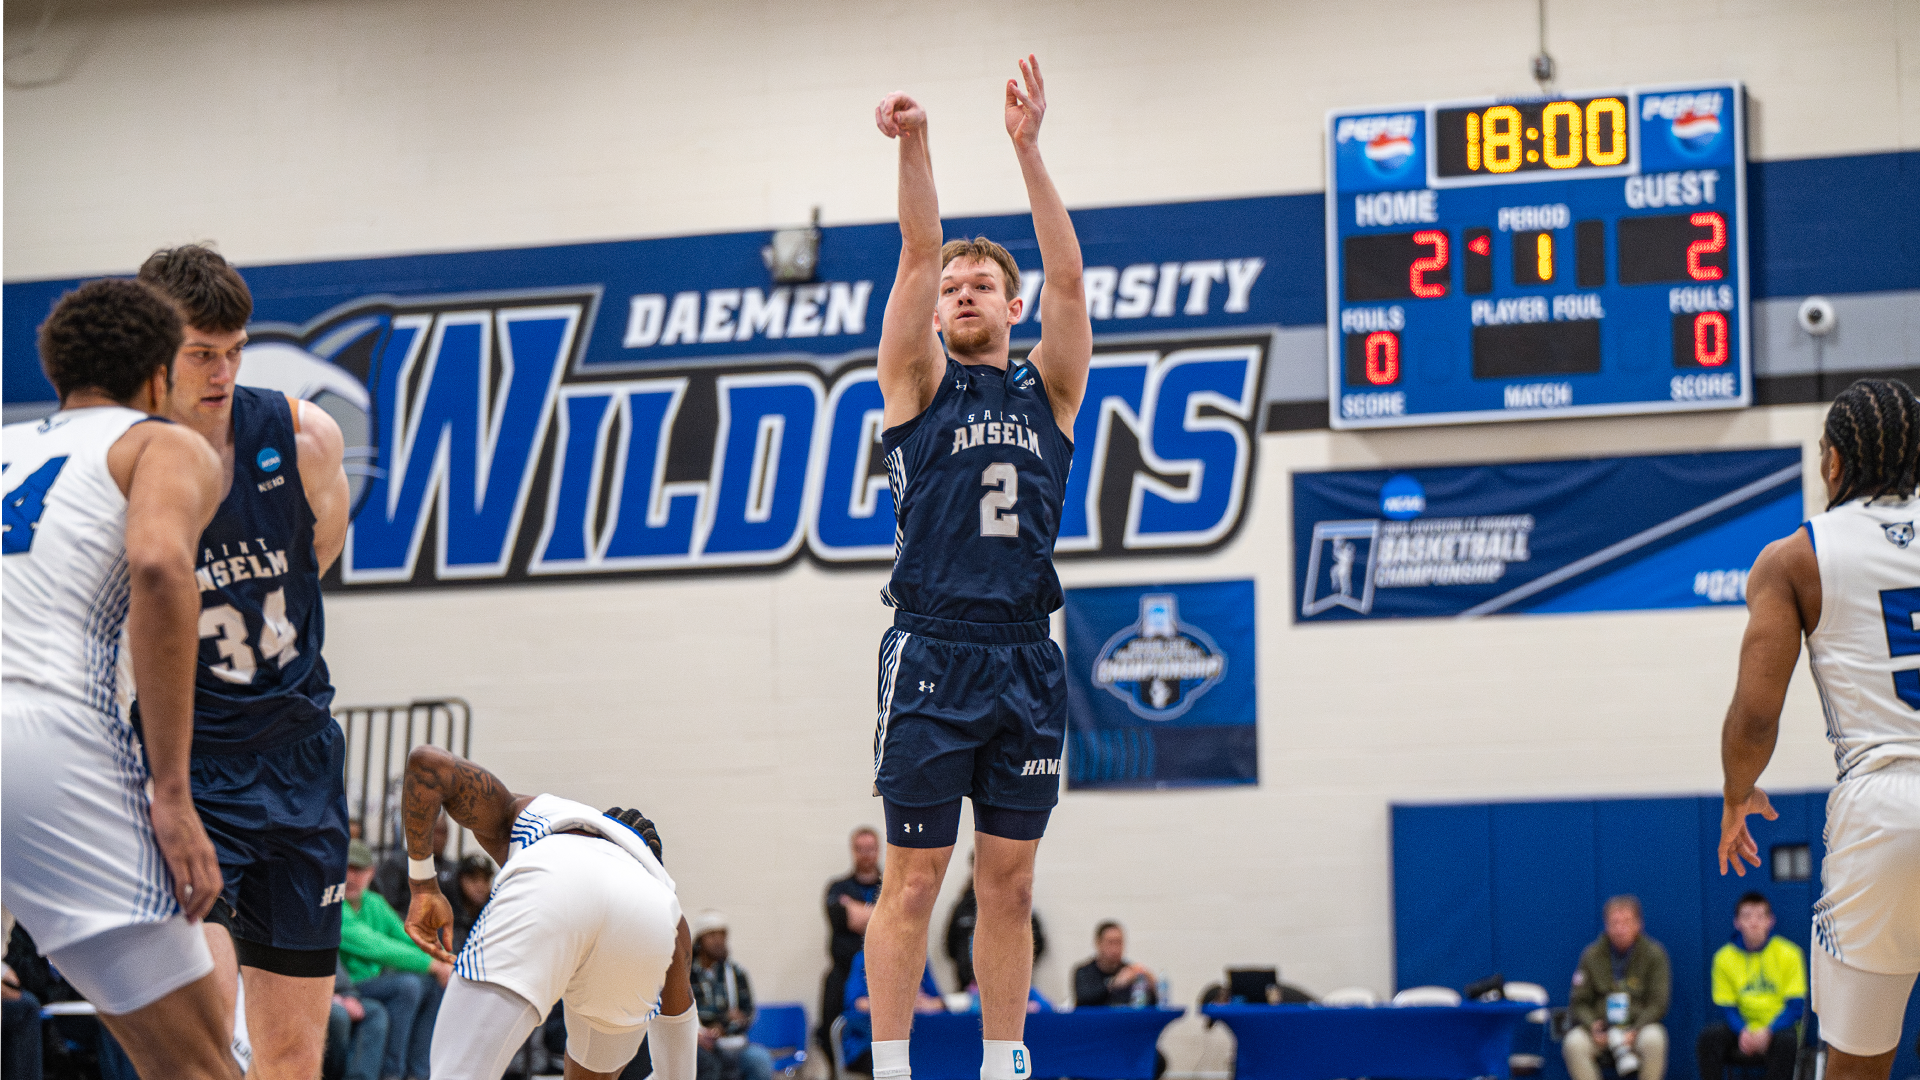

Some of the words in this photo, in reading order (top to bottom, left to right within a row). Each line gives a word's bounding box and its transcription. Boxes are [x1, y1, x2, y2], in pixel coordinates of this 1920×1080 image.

[1642, 91, 1725, 121] PEPSI
[1336, 114, 1417, 144] PEPSI
[1466, 97, 1627, 173] 18:00
[1625, 171, 1719, 209] GUEST
[1355, 190, 1438, 228] HOME
[1498, 203, 1570, 231] PERIOD
[1410, 229, 1450, 298] 2
[1538, 232, 1552, 281] 1
[1686, 211, 1727, 280] 2
[622, 280, 874, 349] DAEMEN
[1471, 299, 1549, 326] PLAYER
[1553, 294, 1605, 322] FOUL
[1669, 285, 1734, 313] FOULS
[1342, 306, 1404, 333] FOULS
[1694, 311, 1728, 366] 0
[1365, 330, 1399, 385] 0
[1342, 391, 1406, 418] SCORE
[1503, 383, 1573, 408] MATCH
[1670, 374, 1735, 402] SCORE
[967, 409, 1029, 426] SAINT
[342, 303, 1262, 585] WILDCTS
[951, 422, 1043, 460] ANSELM
[980, 462, 1020, 538] 2
[204, 537, 270, 564] AINT
[1378, 529, 1531, 565] BASKETBALL
[195, 550, 289, 593] NSELM
[1374, 560, 1506, 588] CHAMPIONSHIP
[199, 586, 300, 686] 34
[1021, 758, 1061, 776] HAW
